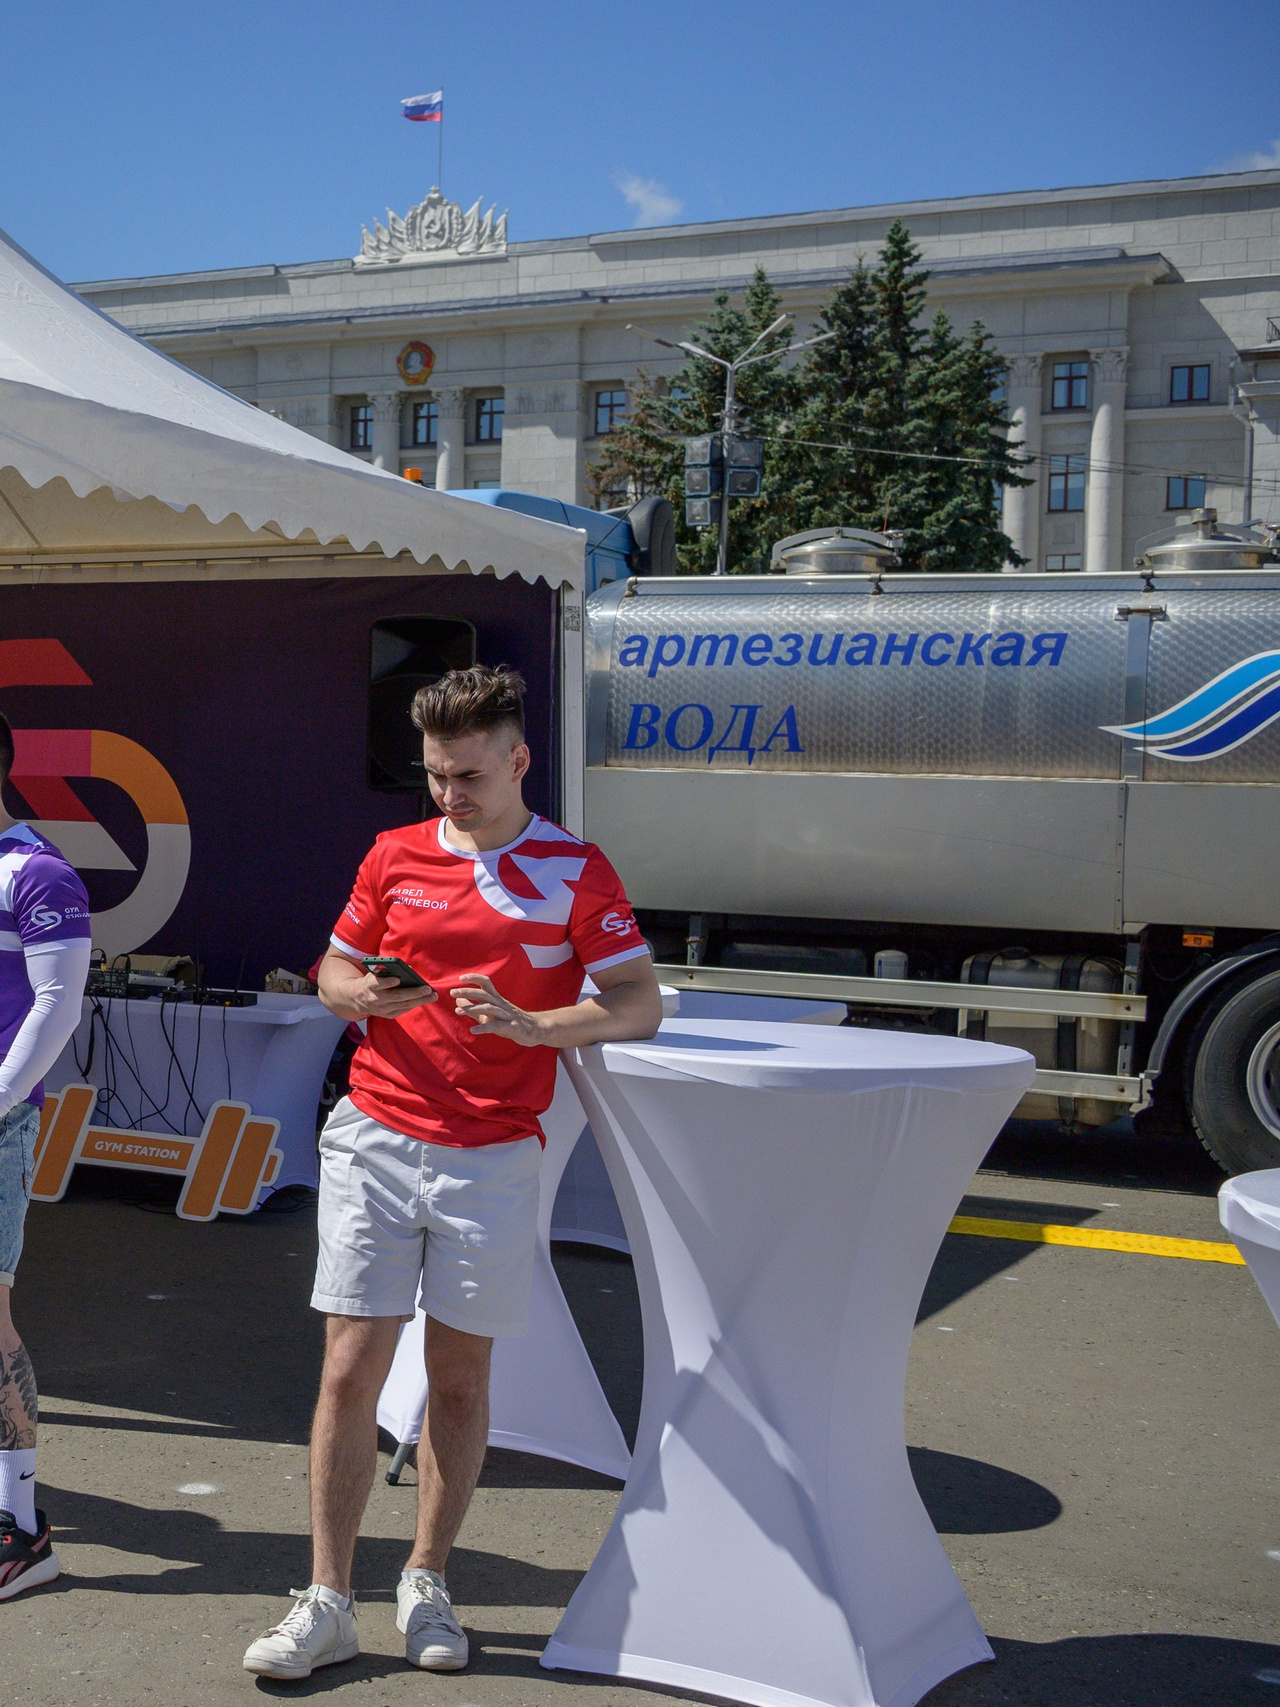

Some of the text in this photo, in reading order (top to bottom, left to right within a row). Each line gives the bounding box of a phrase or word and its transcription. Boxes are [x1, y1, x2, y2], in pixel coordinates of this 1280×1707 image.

[619, 632, 1068, 678] артезианская
[621, 703, 805, 765] ВОДА
[94, 1140, 180, 1160] GYM STATION
